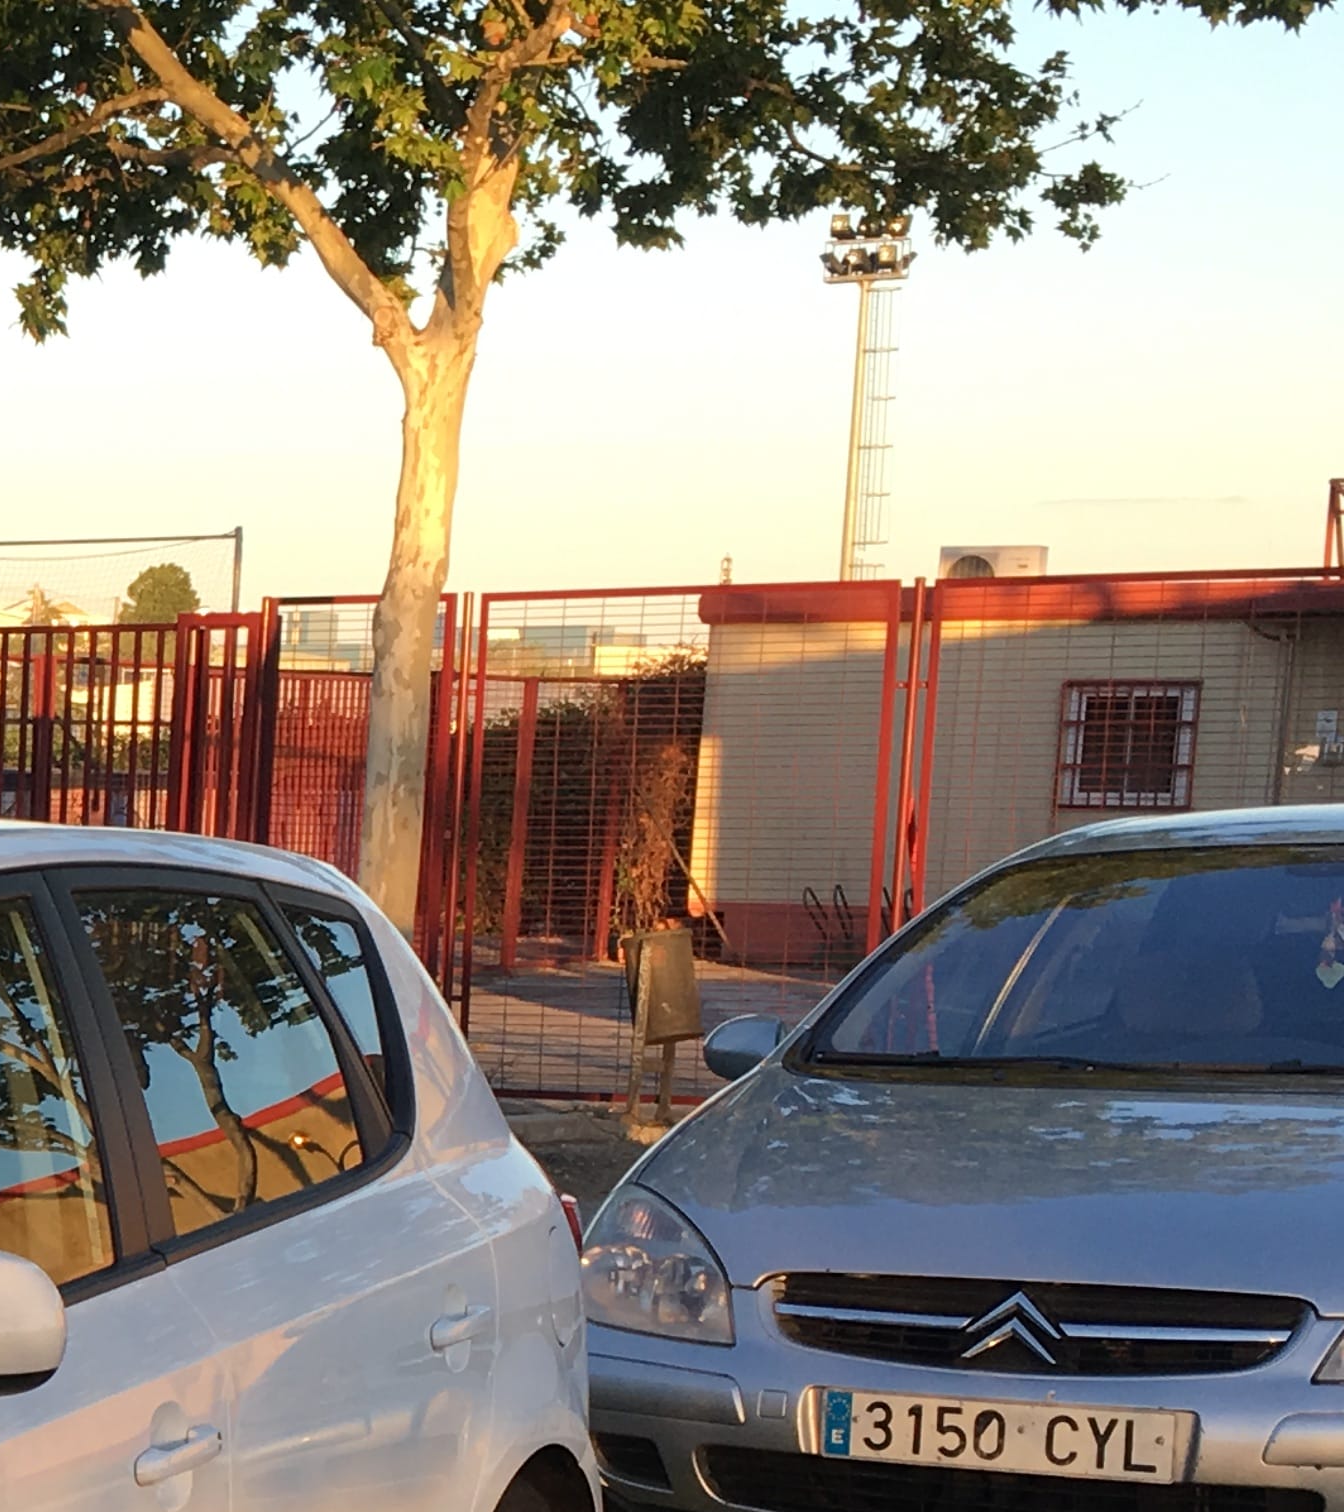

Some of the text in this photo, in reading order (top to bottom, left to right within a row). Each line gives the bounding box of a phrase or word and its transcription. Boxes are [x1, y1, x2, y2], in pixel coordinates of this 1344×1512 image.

[831, 1401, 1157, 1474] E 3150 CYL
